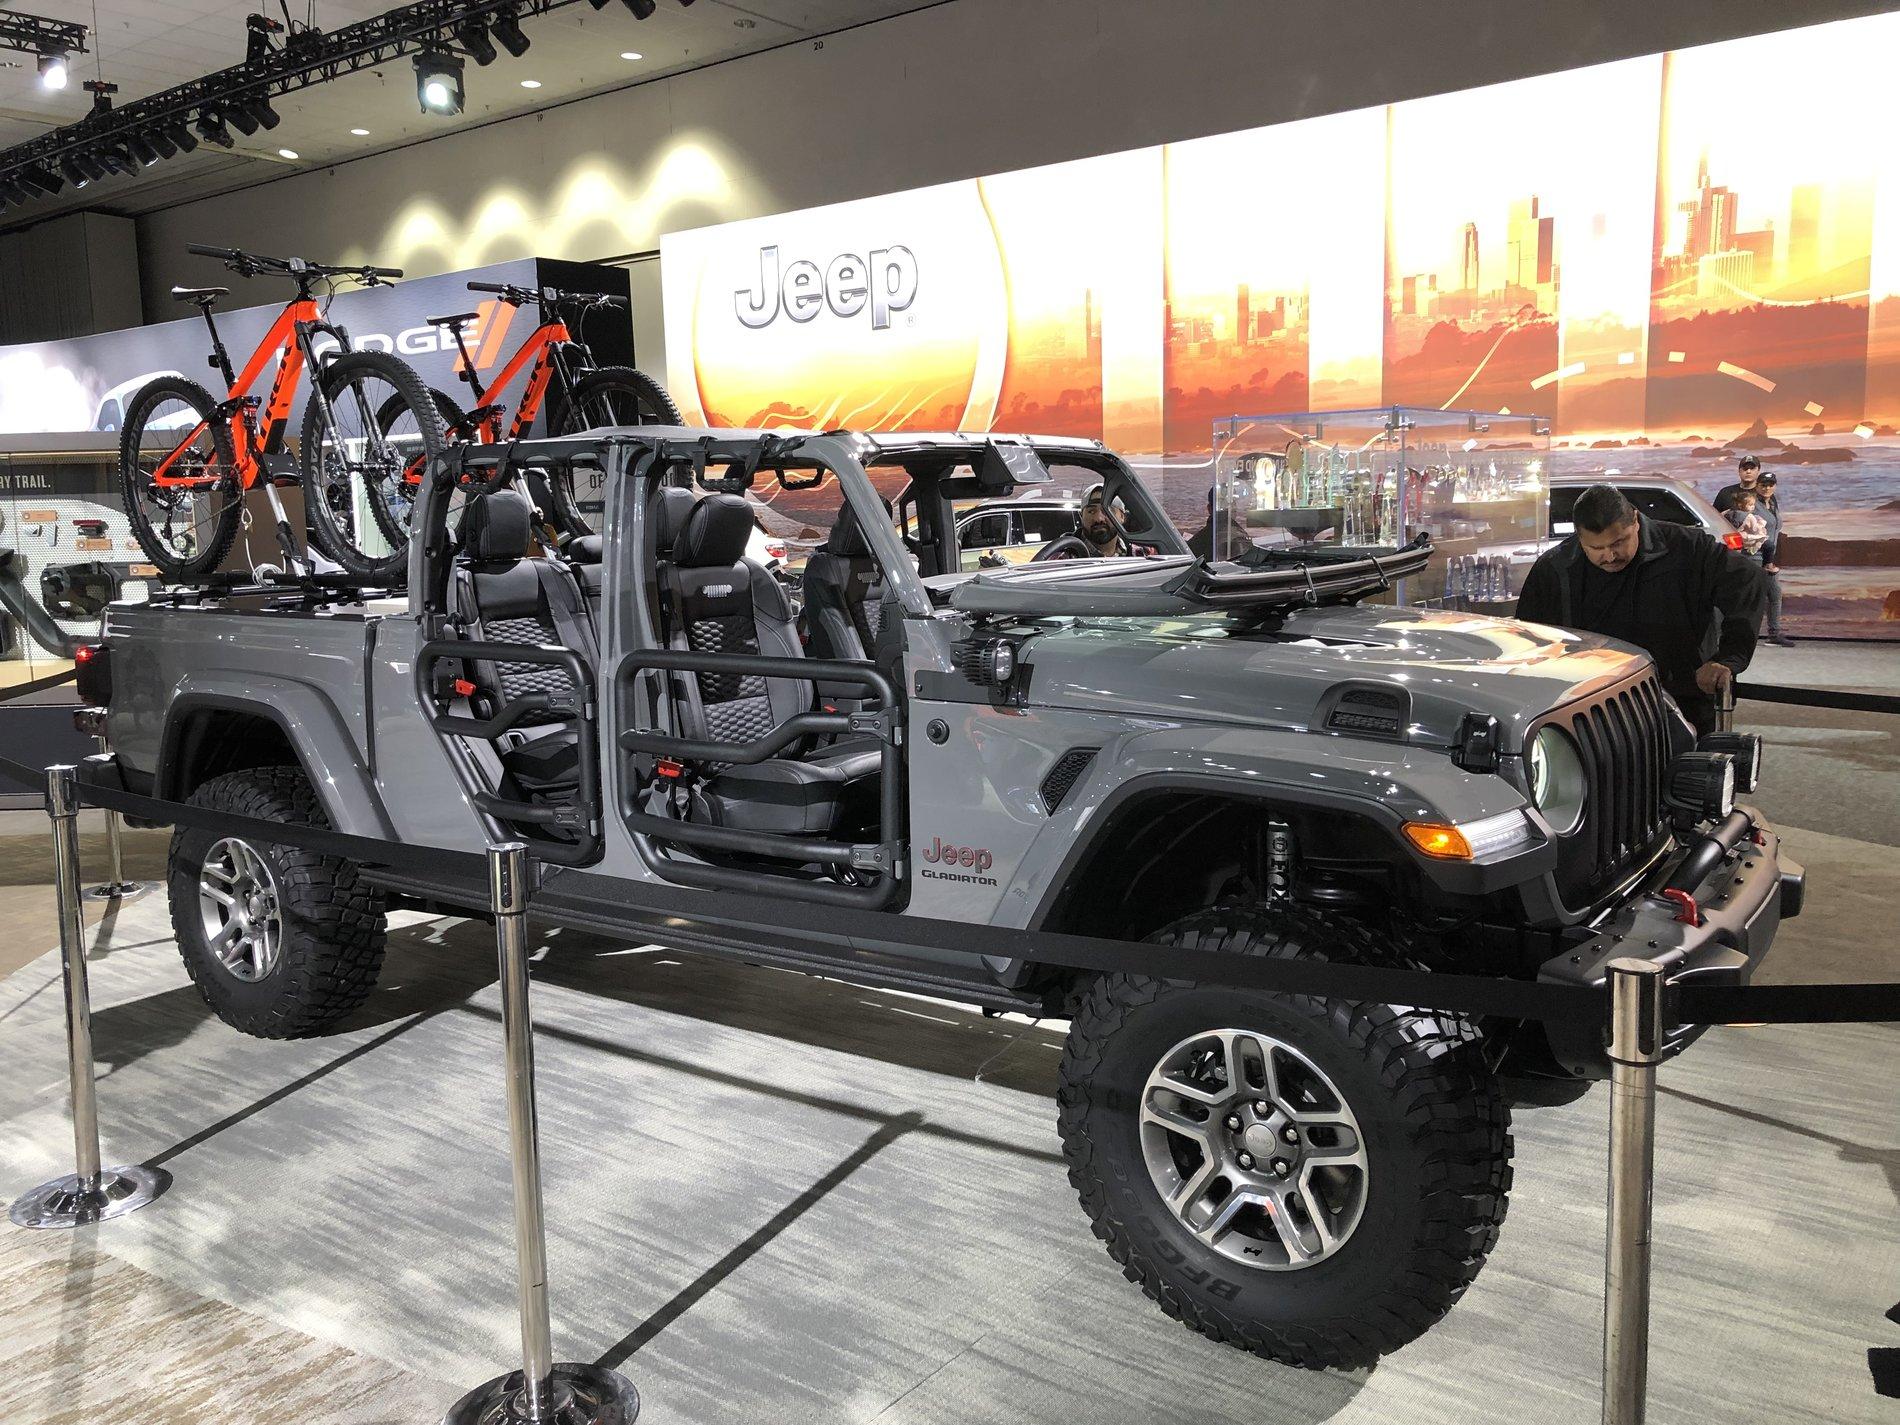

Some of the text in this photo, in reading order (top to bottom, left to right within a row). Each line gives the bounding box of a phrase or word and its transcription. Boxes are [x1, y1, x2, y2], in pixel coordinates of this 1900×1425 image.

[813, 40, 824, 51] 20
[734, 245, 918, 330] Jeep
[15, 475, 51, 489] TRAIL.
[922, 837, 992, 874] Jeep
[921, 869, 997, 886] GLADIATOR
